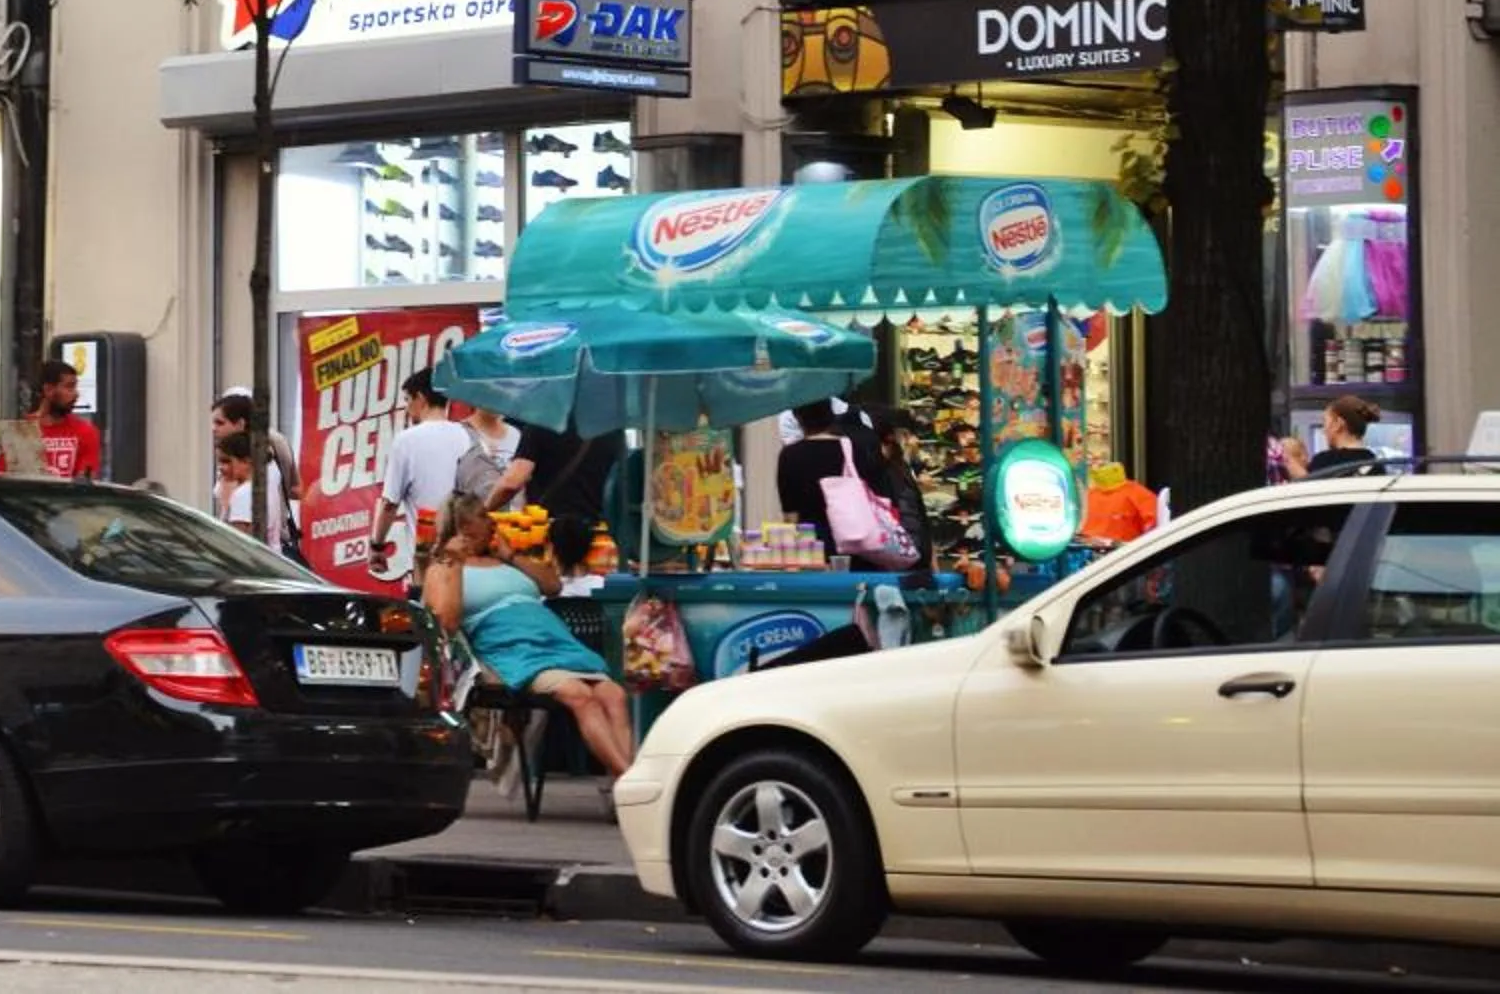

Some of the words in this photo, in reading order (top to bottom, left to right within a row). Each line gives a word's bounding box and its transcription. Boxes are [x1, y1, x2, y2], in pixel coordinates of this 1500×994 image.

[349, 3, 455, 32] sportska
[1016, 53, 1074, 72] LUXURY
[1077, 50, 1131, 68] SUITES
[317, 337, 381, 385] FINALNO
[344, 540, 365, 560] DO
[754, 627, 805, 649] CREAM
